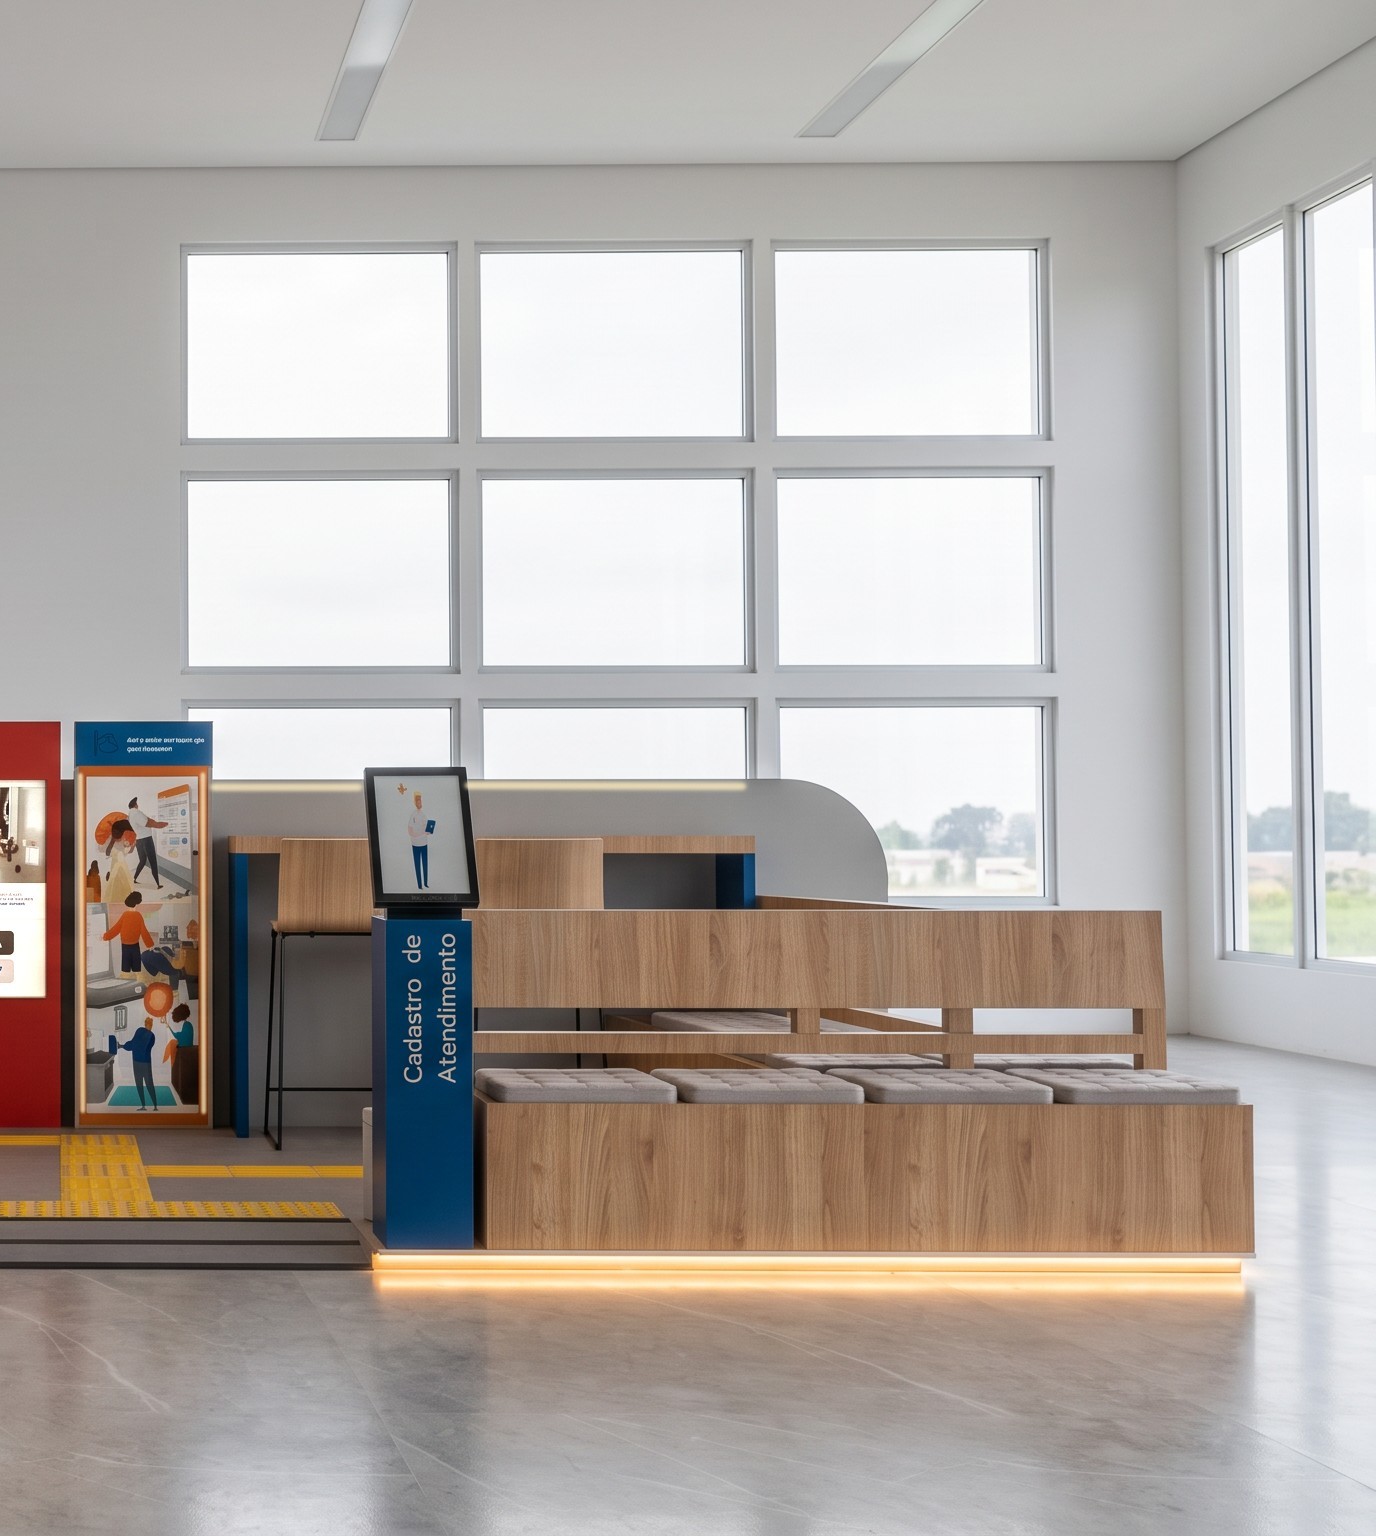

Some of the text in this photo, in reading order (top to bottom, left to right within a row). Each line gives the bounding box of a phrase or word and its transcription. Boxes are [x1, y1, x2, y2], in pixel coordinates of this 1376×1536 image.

[402, 934, 423, 1084] Cadastro de
[436, 933, 457, 1084] Atendimento
